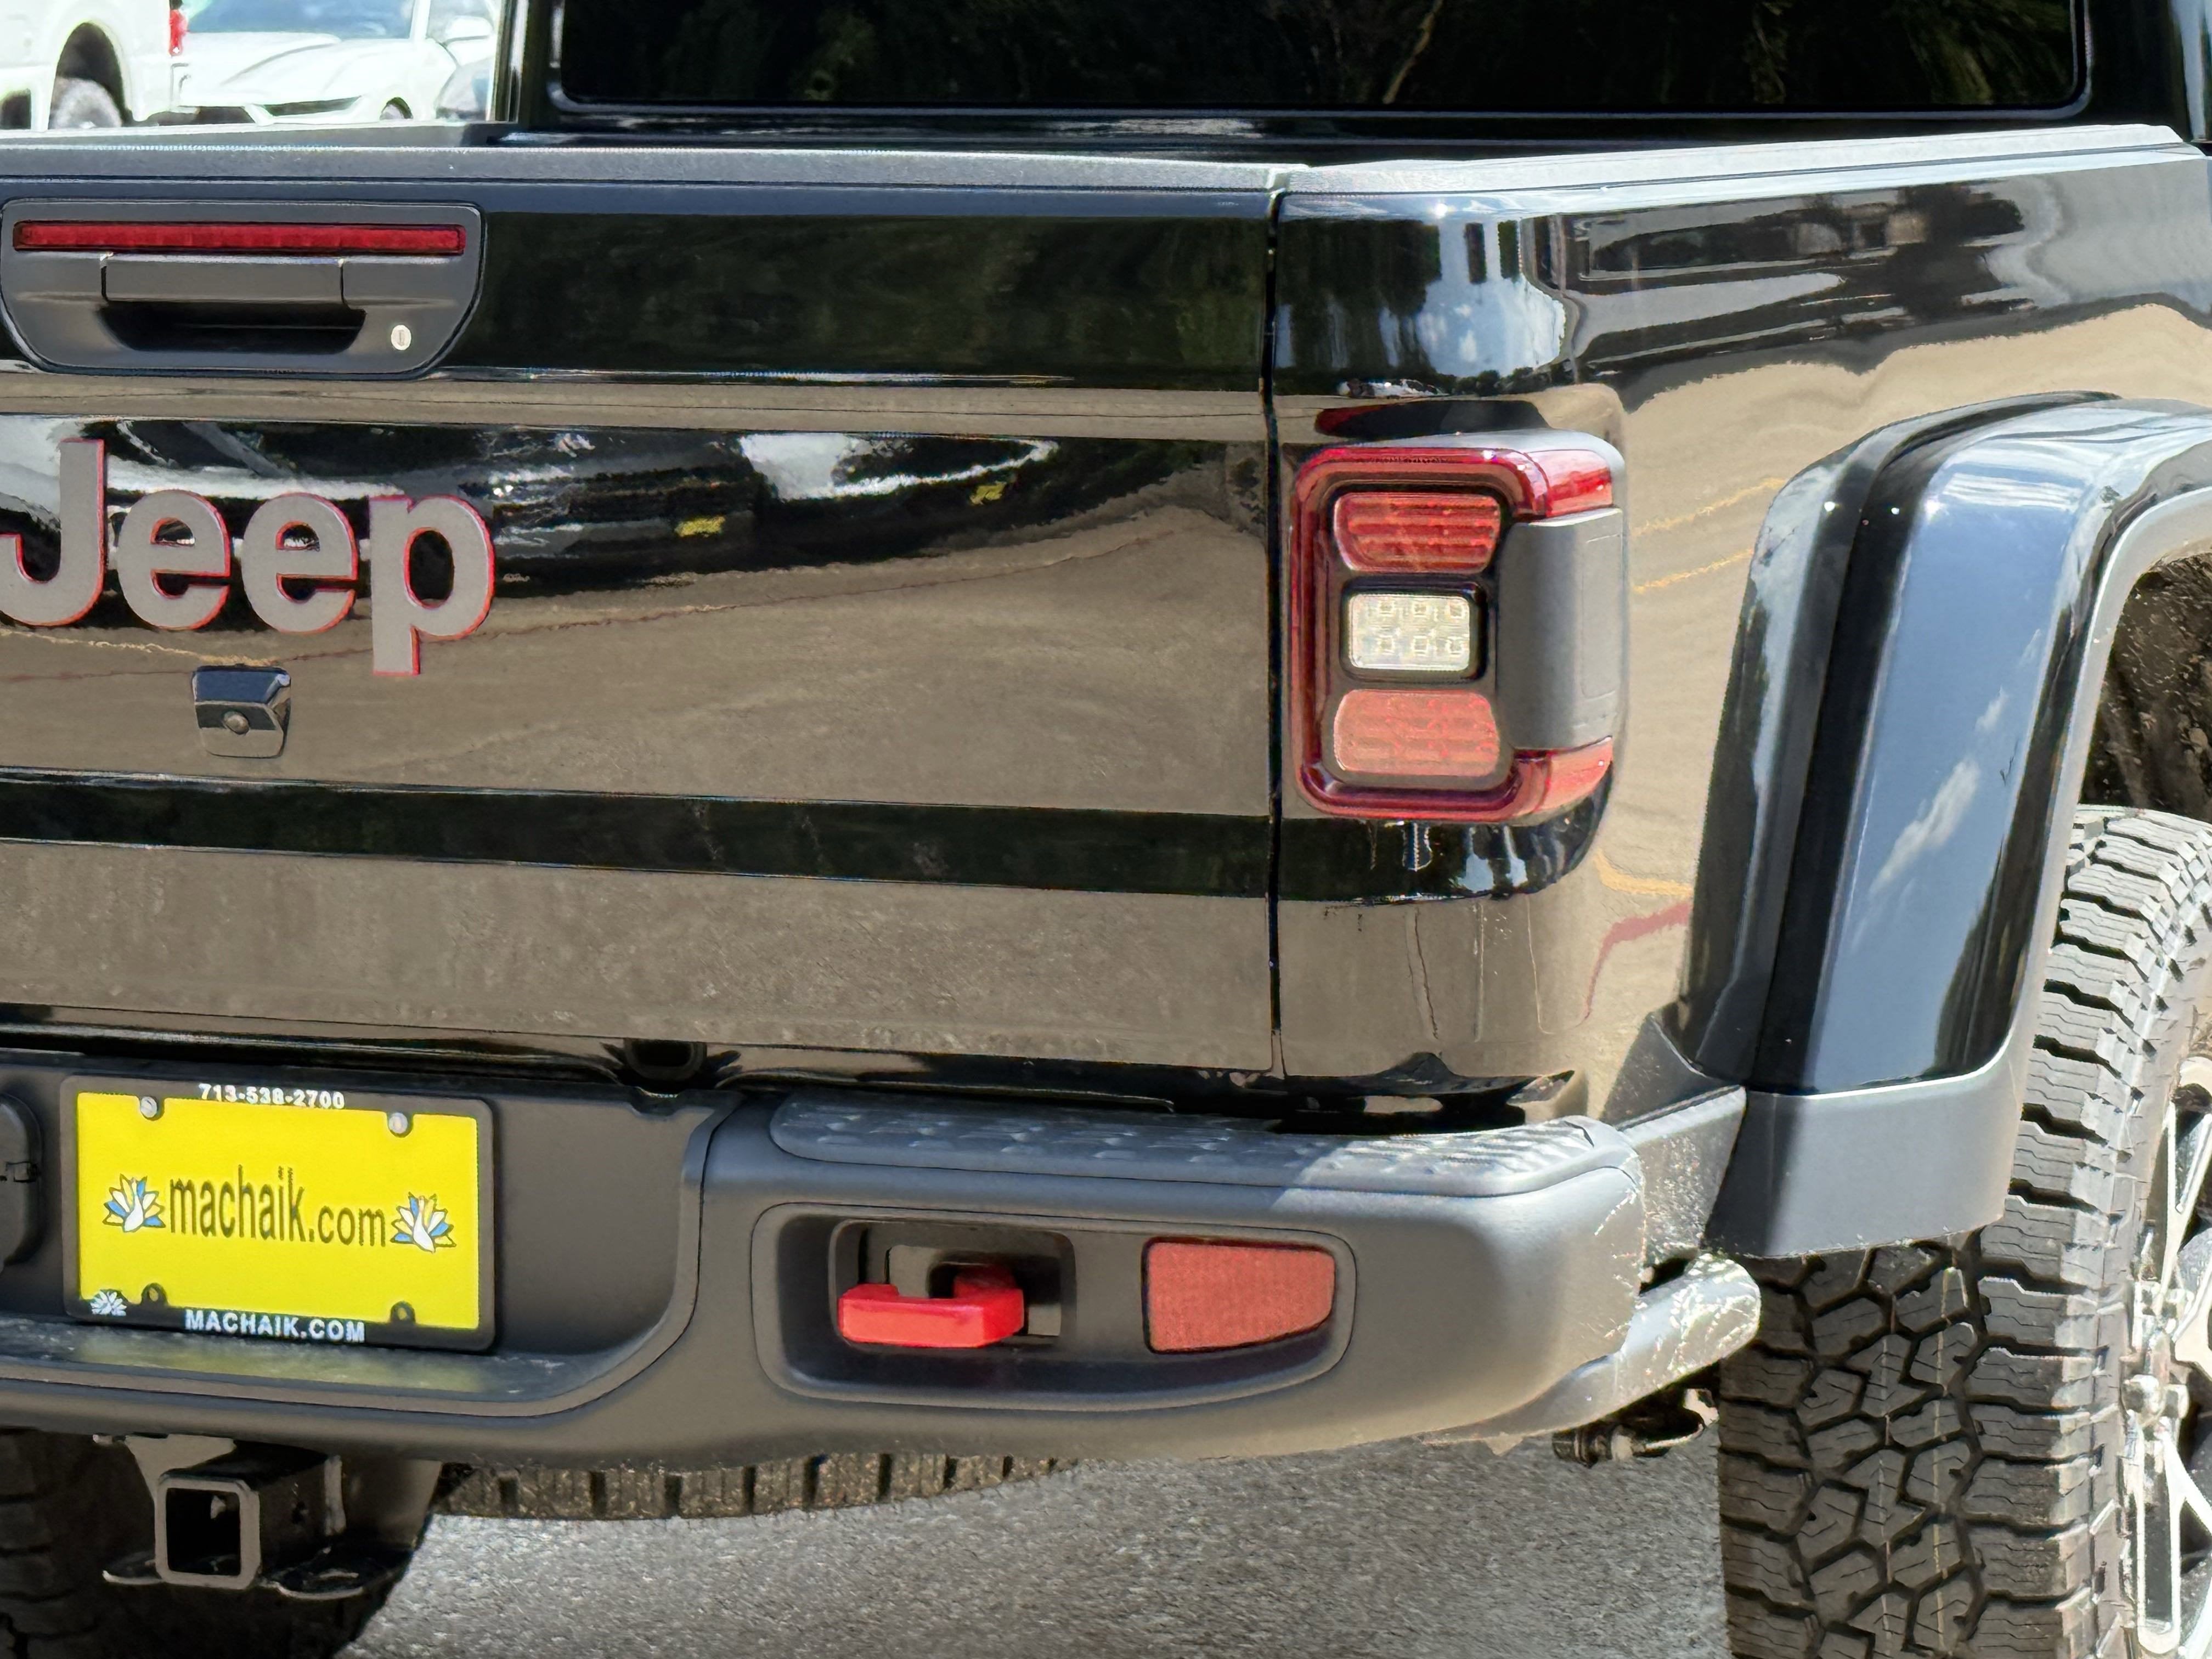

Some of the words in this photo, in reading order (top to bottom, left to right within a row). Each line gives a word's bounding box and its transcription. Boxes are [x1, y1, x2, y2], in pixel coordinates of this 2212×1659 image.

[0, 438, 495, 676] Jeep
[199, 1083, 345, 1109] 713-538-2700
[170, 1164, 386, 1247] machaik.com
[184, 1309, 365, 1343] MACHAIK.COM
